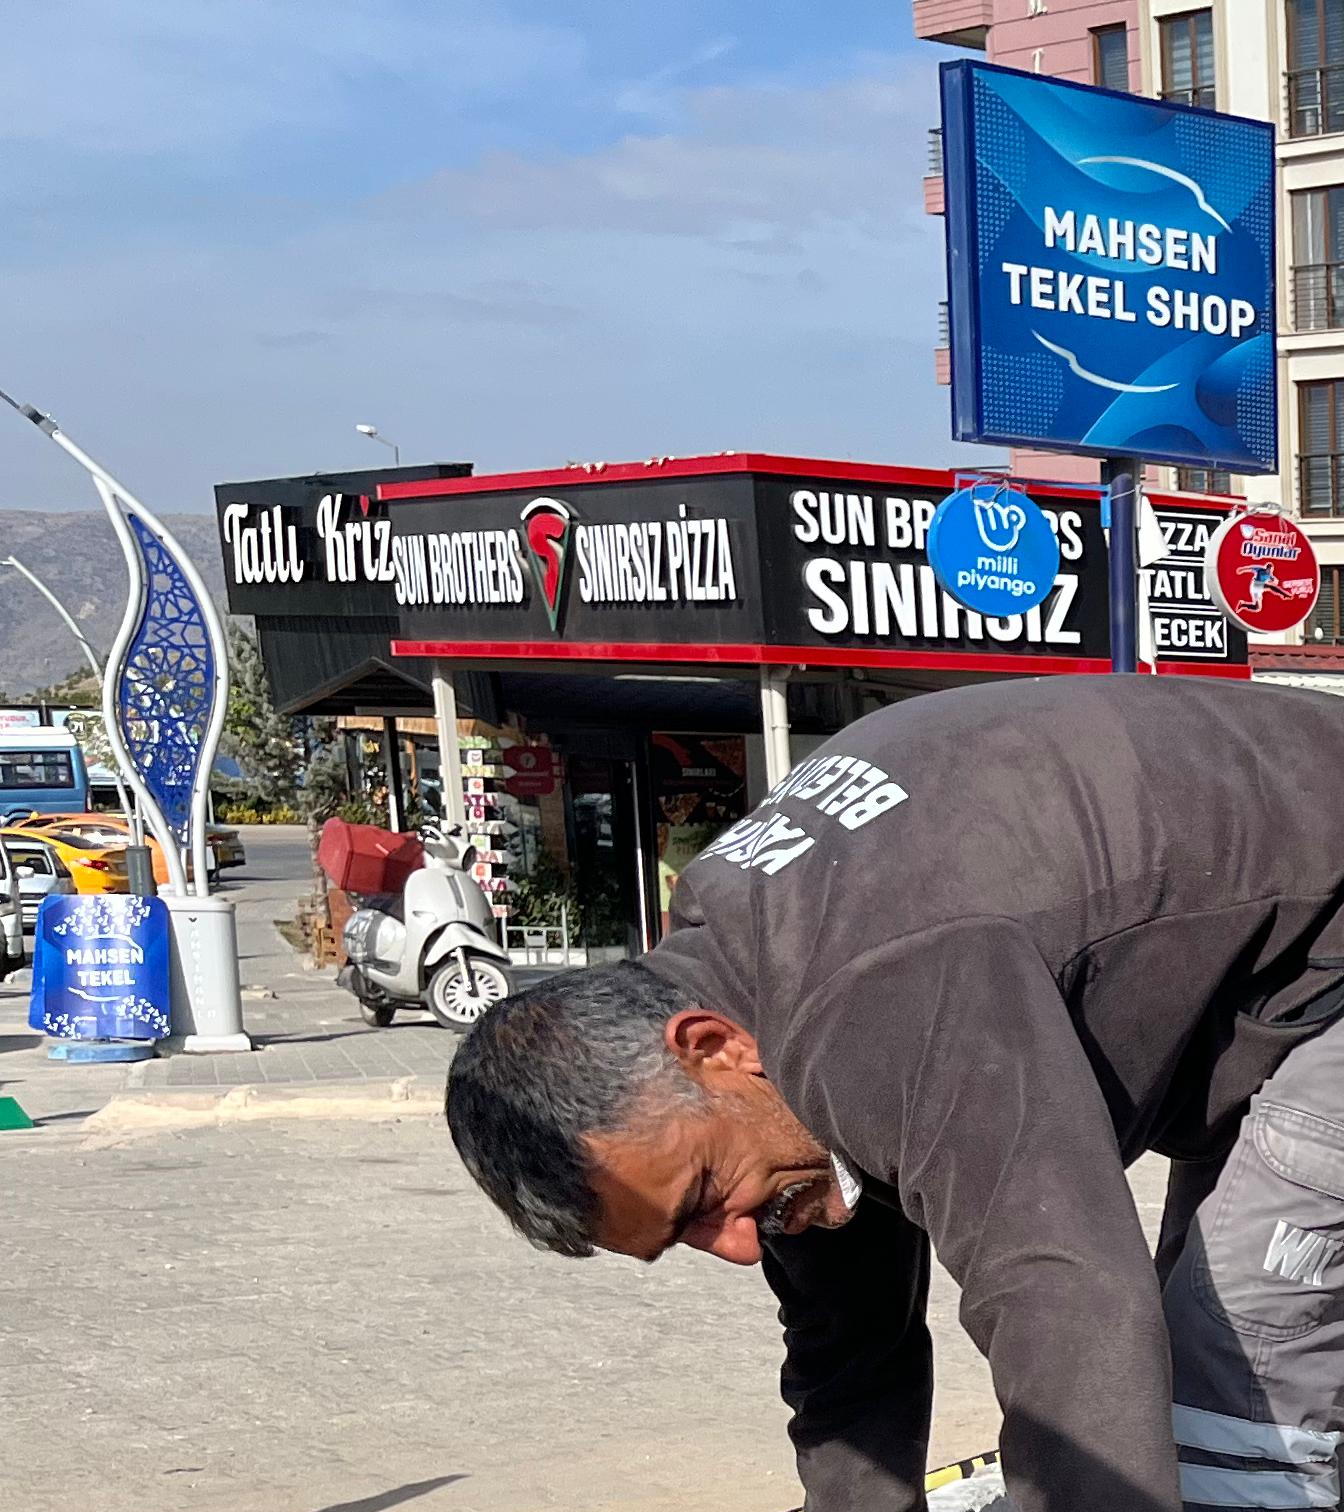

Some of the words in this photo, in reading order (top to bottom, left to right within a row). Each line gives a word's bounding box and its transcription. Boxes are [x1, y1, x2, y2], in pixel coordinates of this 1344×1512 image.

[1043, 206, 1217, 275] MAHSEN
[1002, 262, 1137, 322] TEKEL
[1146, 285, 1256, 338] SHOP
[223, 503, 304, 585] Tatlı
[316, 493, 396, 583] Kriz
[792, 490, 875, 546] SUN
[391, 534, 428, 605] SUN
[427, 529, 524, 605] BROTHERS
[575, 522, 667, 603] SINIRSIZ
[665, 503, 737, 602] PİZZA
[976, 554, 1019, 575] milli
[957, 569, 1037, 597] piyango
[66, 948, 145, 966] MAHSEN
[77, 969, 136, 988] TEKEL
